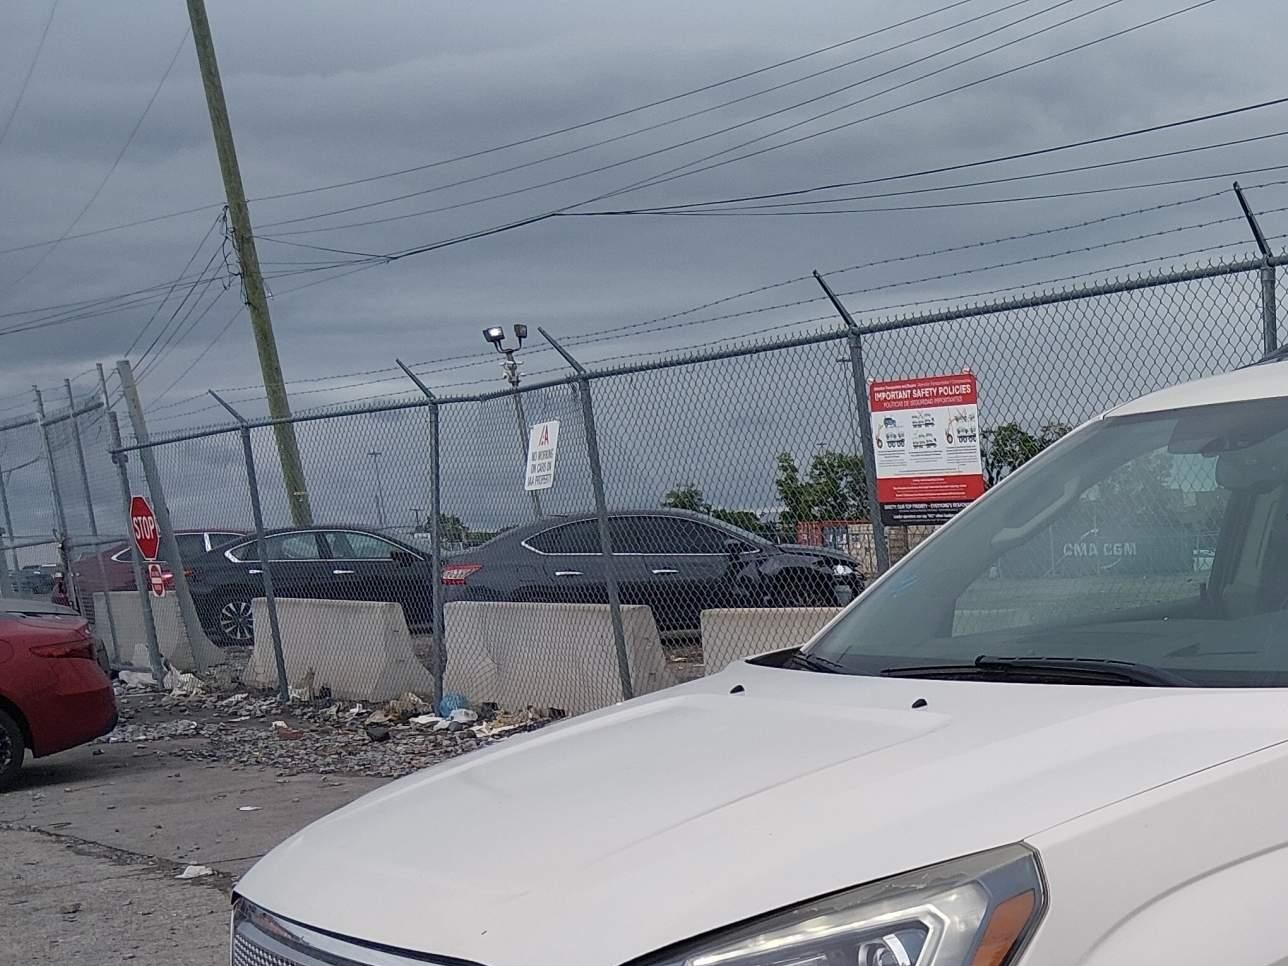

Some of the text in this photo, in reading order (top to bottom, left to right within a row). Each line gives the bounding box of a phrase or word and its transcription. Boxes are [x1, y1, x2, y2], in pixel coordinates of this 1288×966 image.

[874, 390, 911, 402] IMPORTANT
[912, 386, 938, 399] SAFETY
[938, 384, 971, 396] POLICIES
[132, 516, 155, 539] STOP
[1063, 543, 1098, 556] CMA
